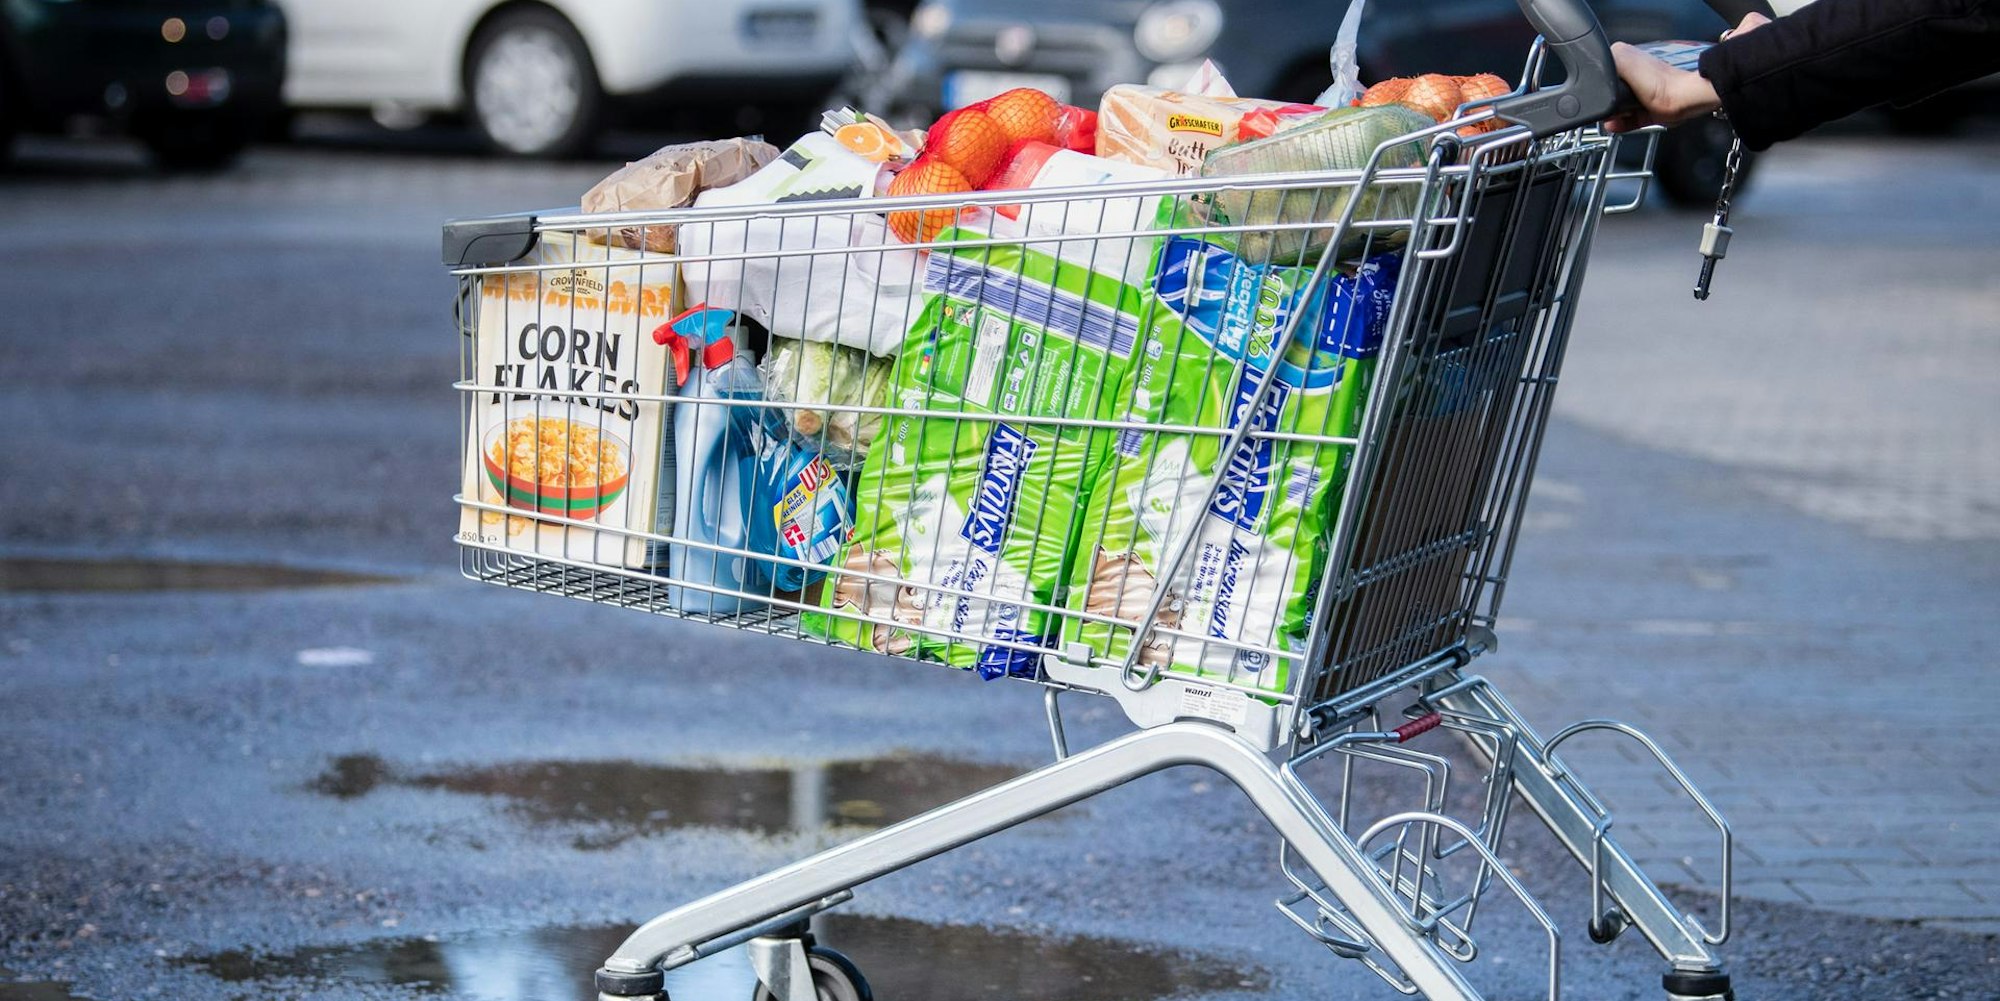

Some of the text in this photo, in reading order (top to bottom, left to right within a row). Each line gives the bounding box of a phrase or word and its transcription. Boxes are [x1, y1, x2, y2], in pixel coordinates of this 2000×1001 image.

[1168, 138, 1205, 161] Butt
[550, 276, 604, 293] CROWNFIELD
[1249, 272, 1283, 358] 100%
[518, 323, 621, 371] CORN
[491, 364, 641, 421] FLAKES
[461, 530, 477, 541] 850
